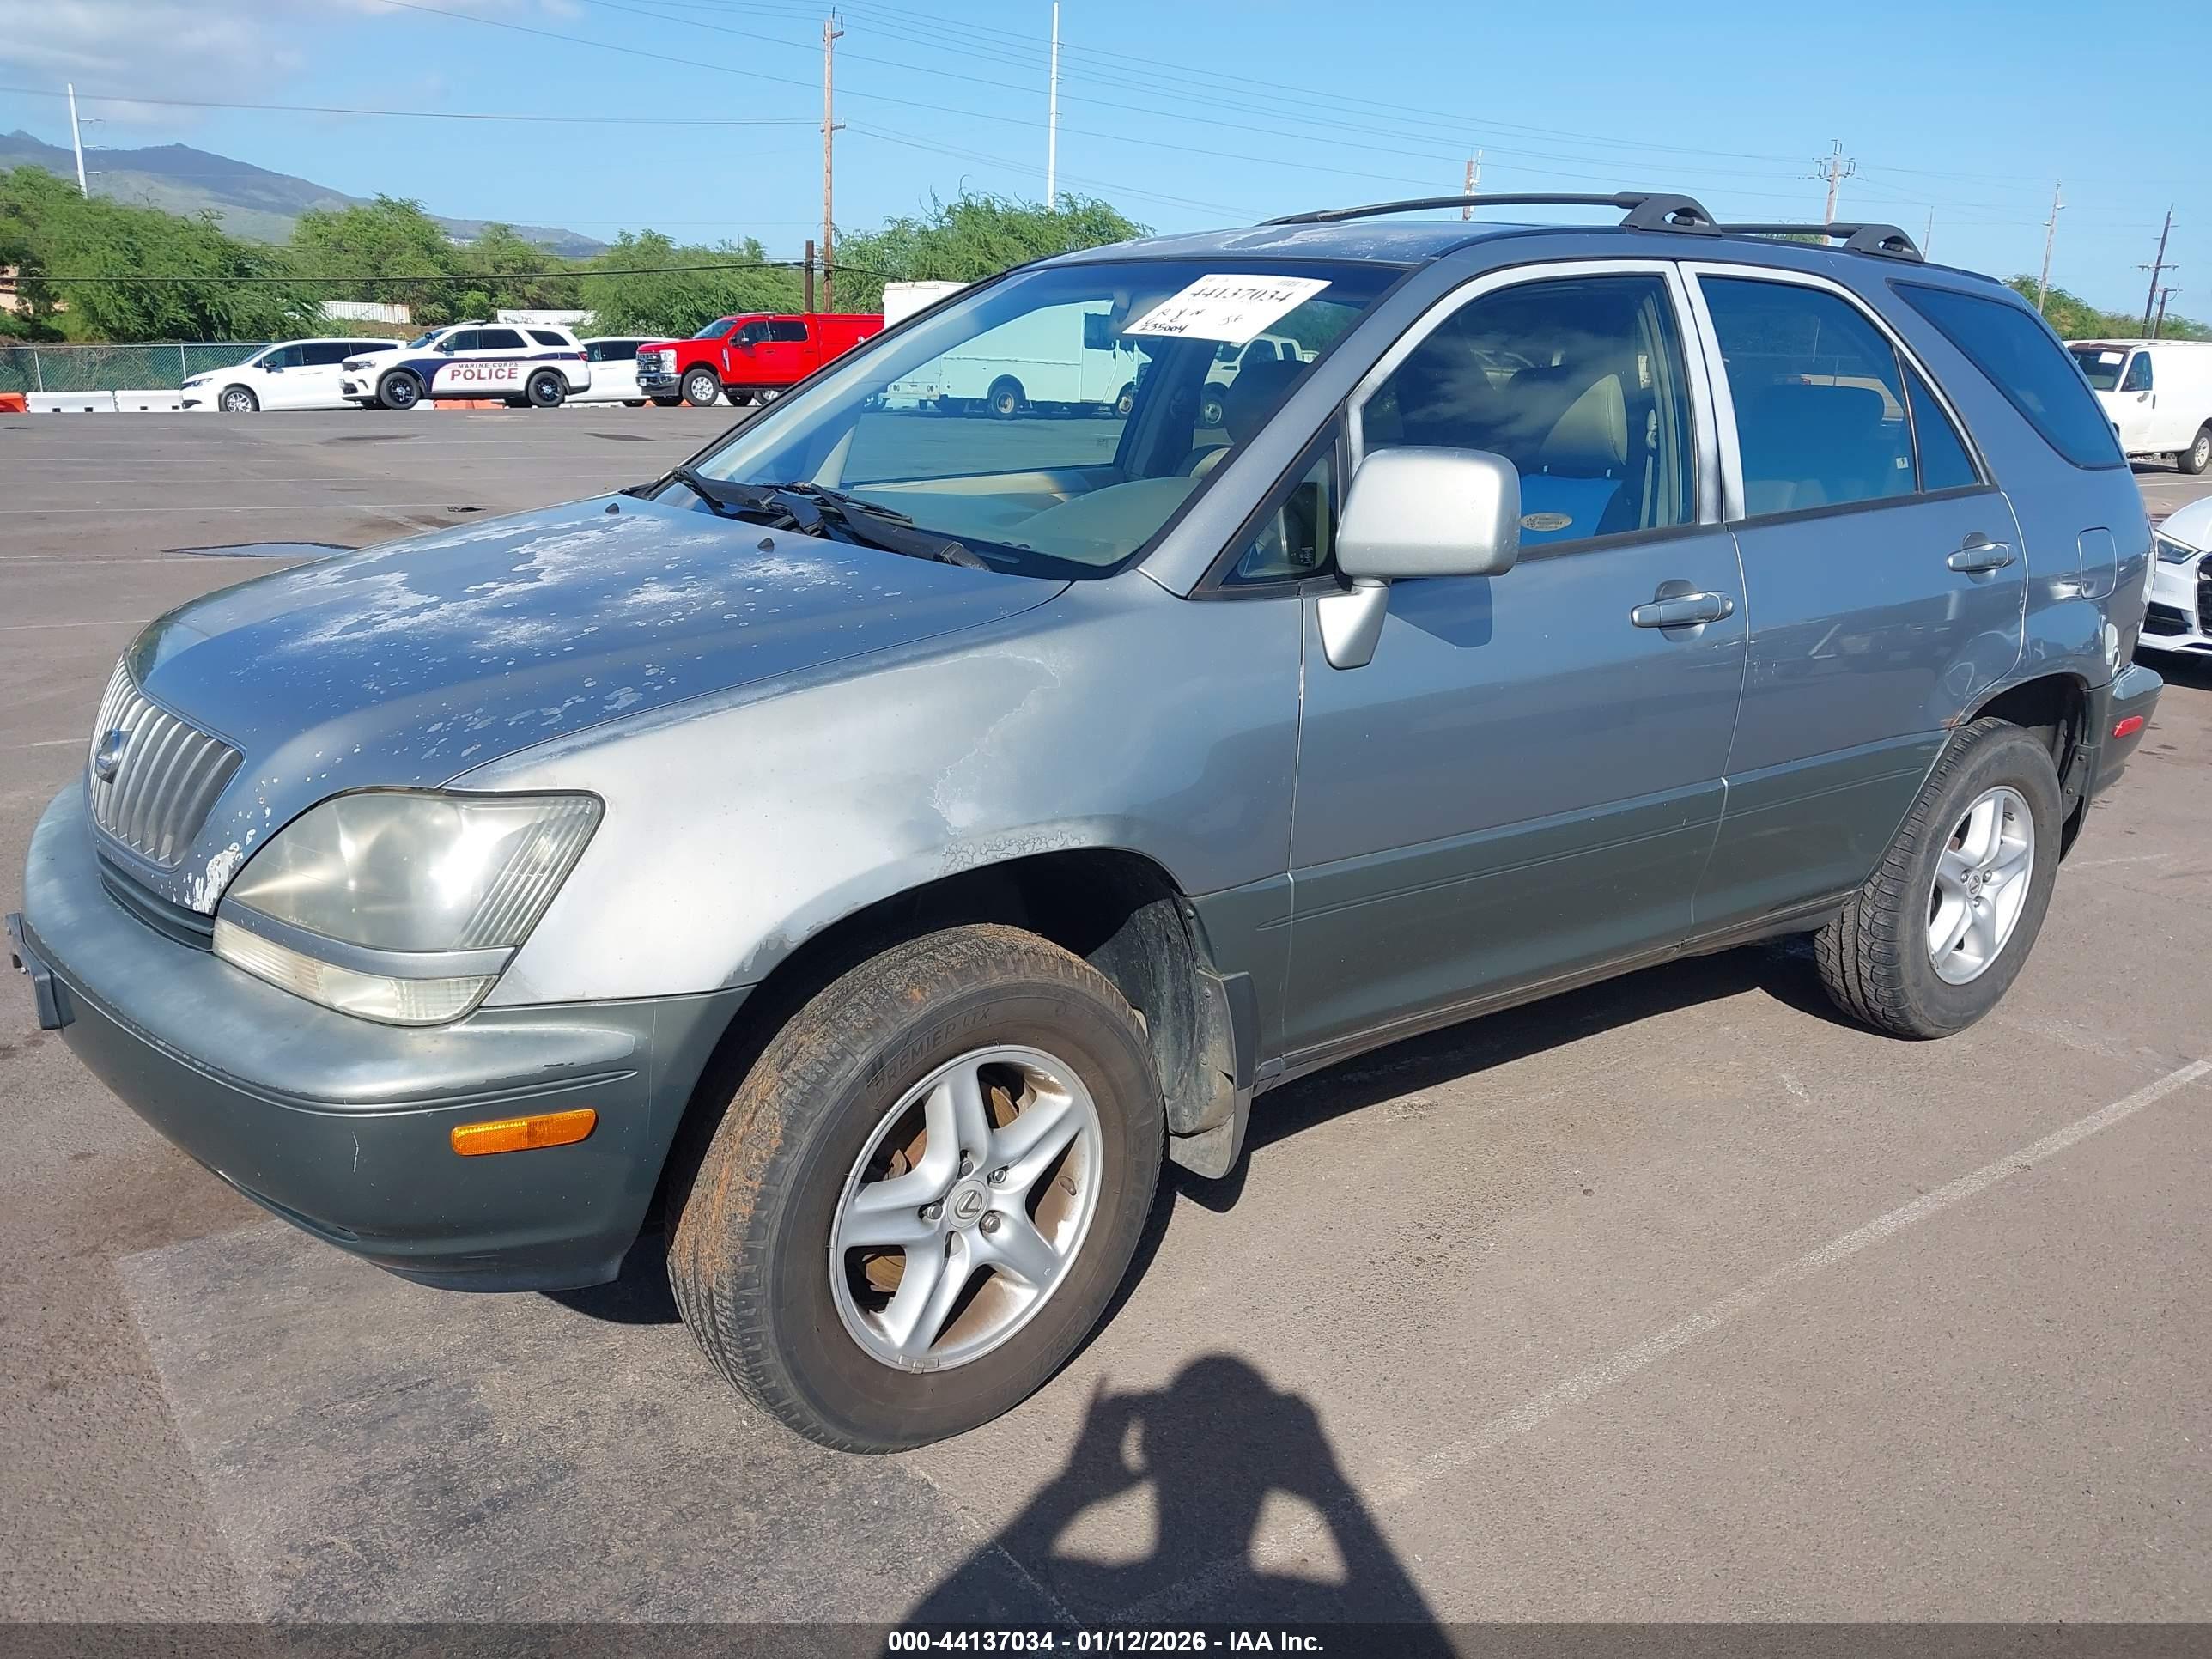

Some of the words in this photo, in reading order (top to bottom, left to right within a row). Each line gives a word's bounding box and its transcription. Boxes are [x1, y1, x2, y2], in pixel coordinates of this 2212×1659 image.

[1191, 288, 1294, 302] 44137034
[450, 368, 519, 380] POLICE
[872, 1022, 957, 1092] PREMIER
